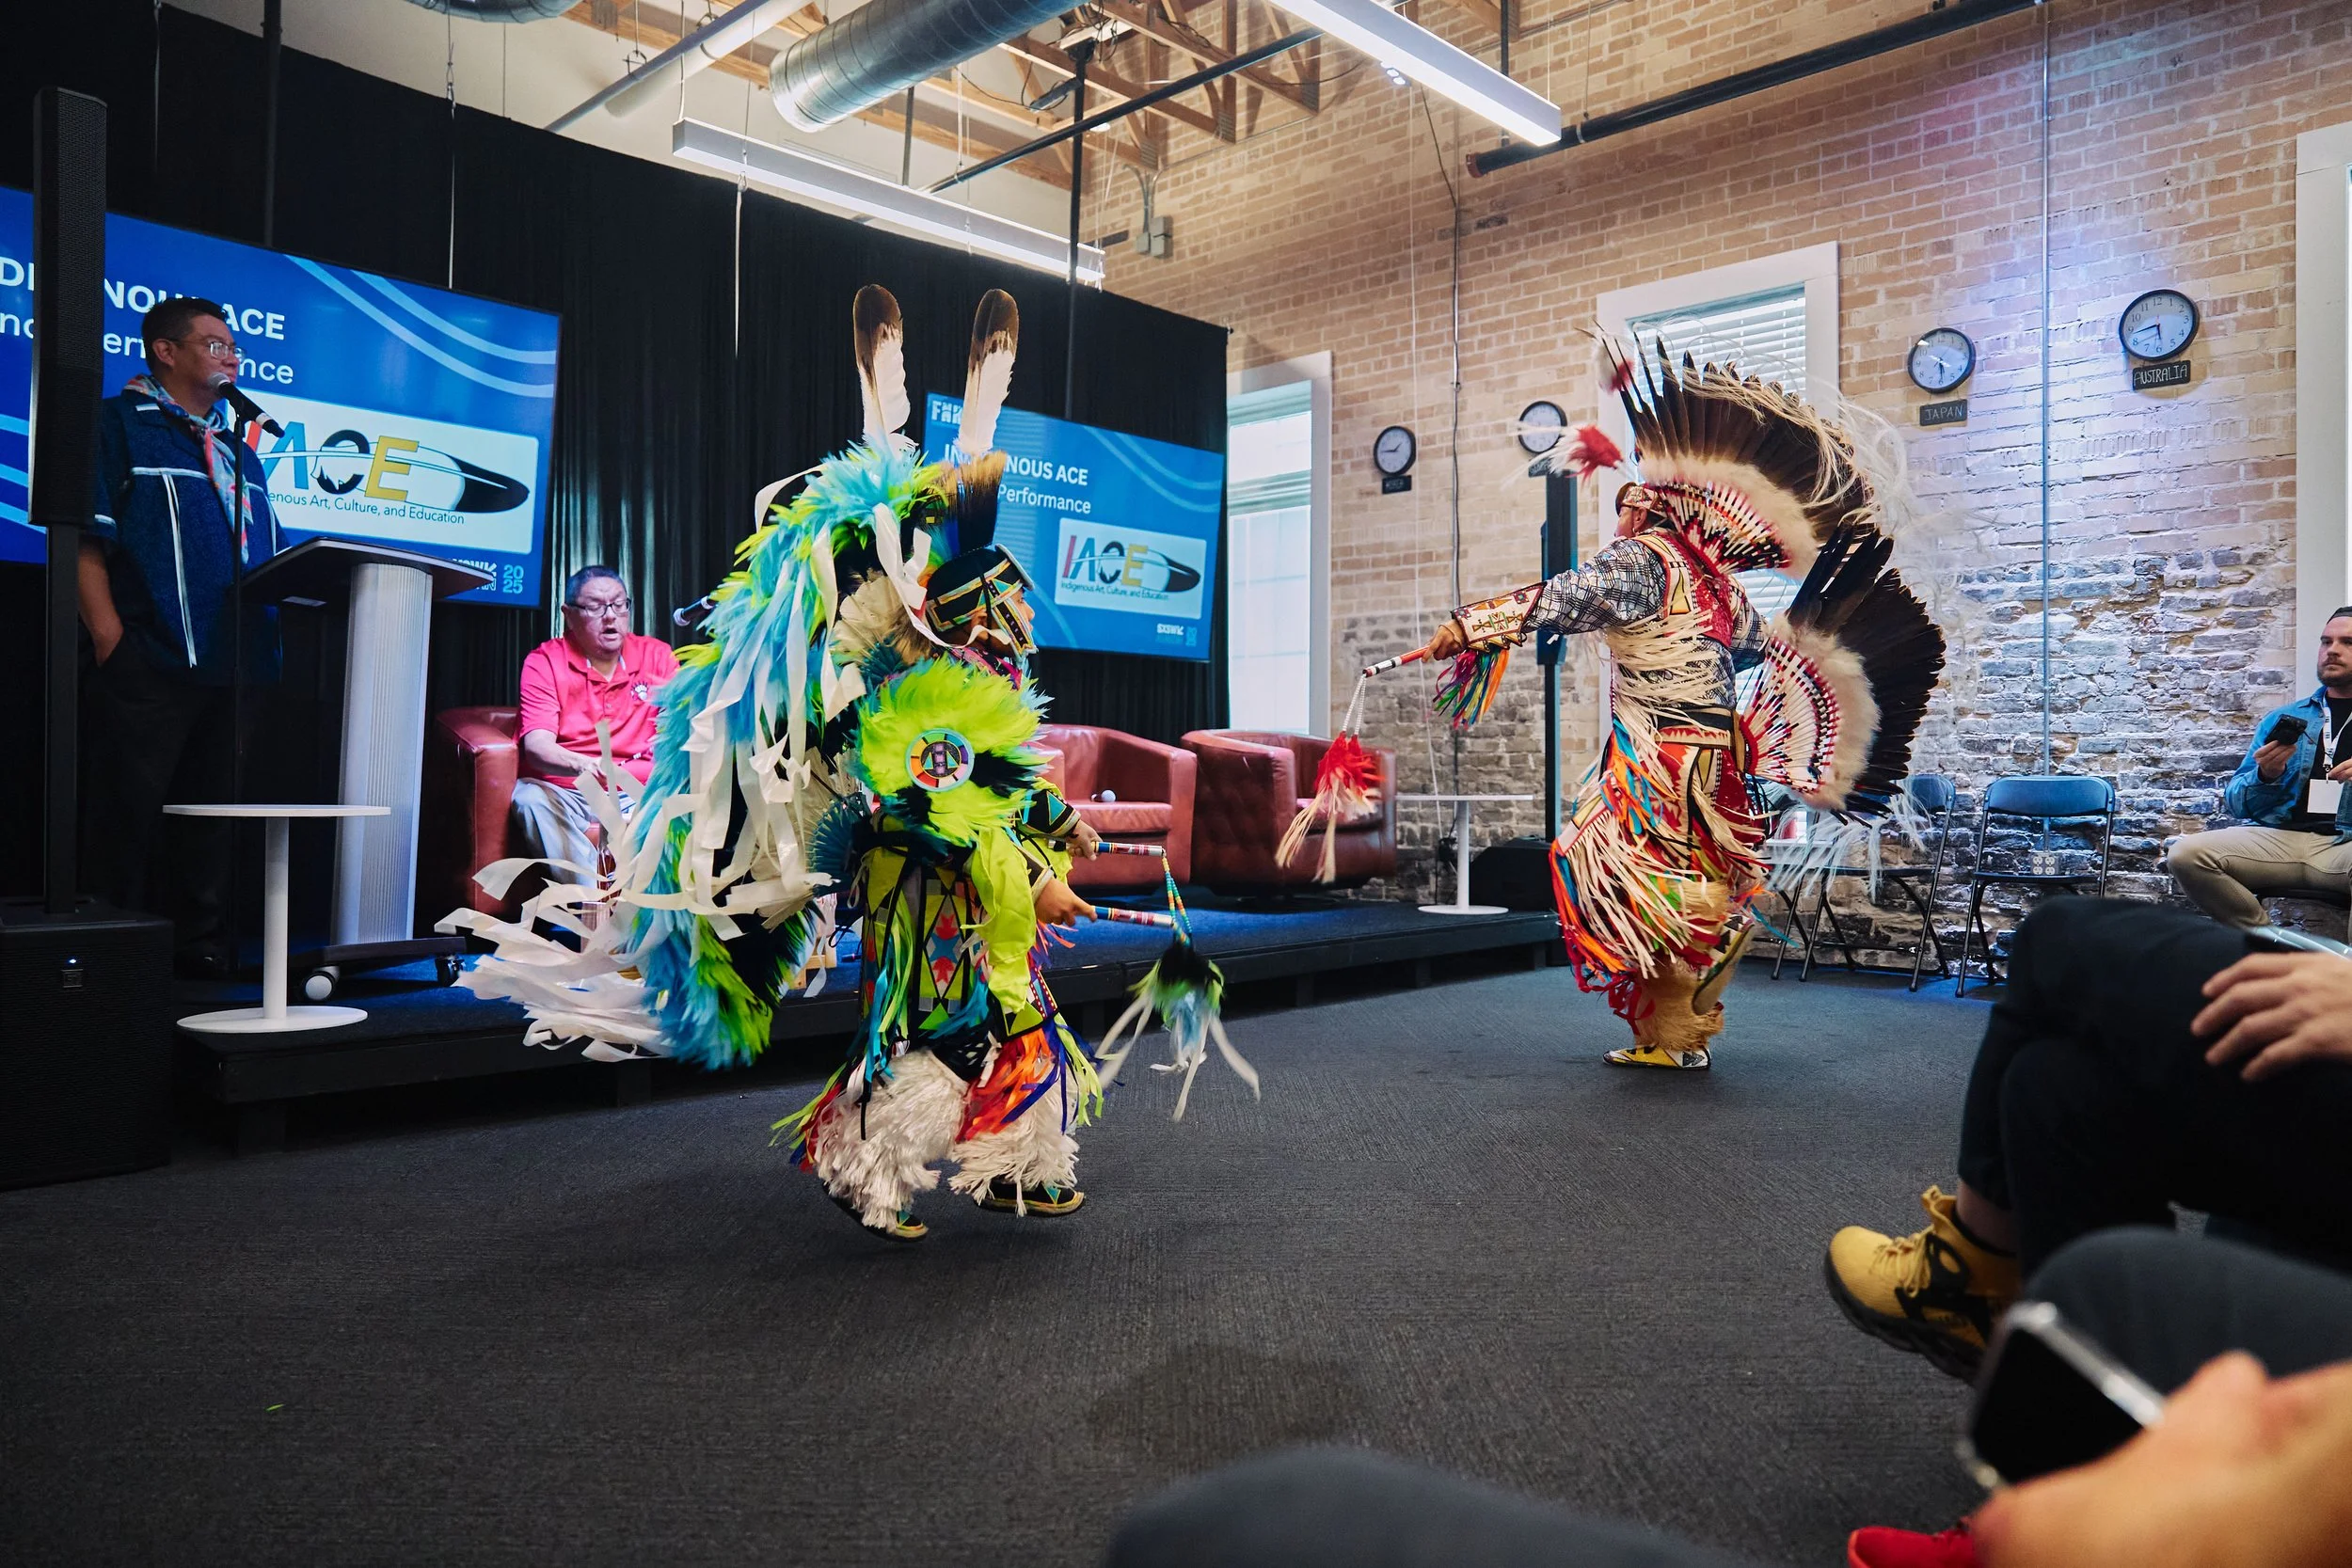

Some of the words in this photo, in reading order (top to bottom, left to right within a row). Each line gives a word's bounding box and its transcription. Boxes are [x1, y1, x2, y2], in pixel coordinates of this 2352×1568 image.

[221, 303, 285, 340] ACE
[2134, 364, 2187, 387] AUSTRALIA
[1925, 404, 1963, 421] JAPAN
[1055, 464, 1089, 486] ACE
[310, 494, 330, 510] Art,
[334, 497, 381, 515] Culture,
[383, 504, 406, 518] and
[409, 506, 465, 525] Education
[997, 483, 1091, 515] Performance
[502, 564, 524, 579] 20
[502, 578, 523, 594] 25
